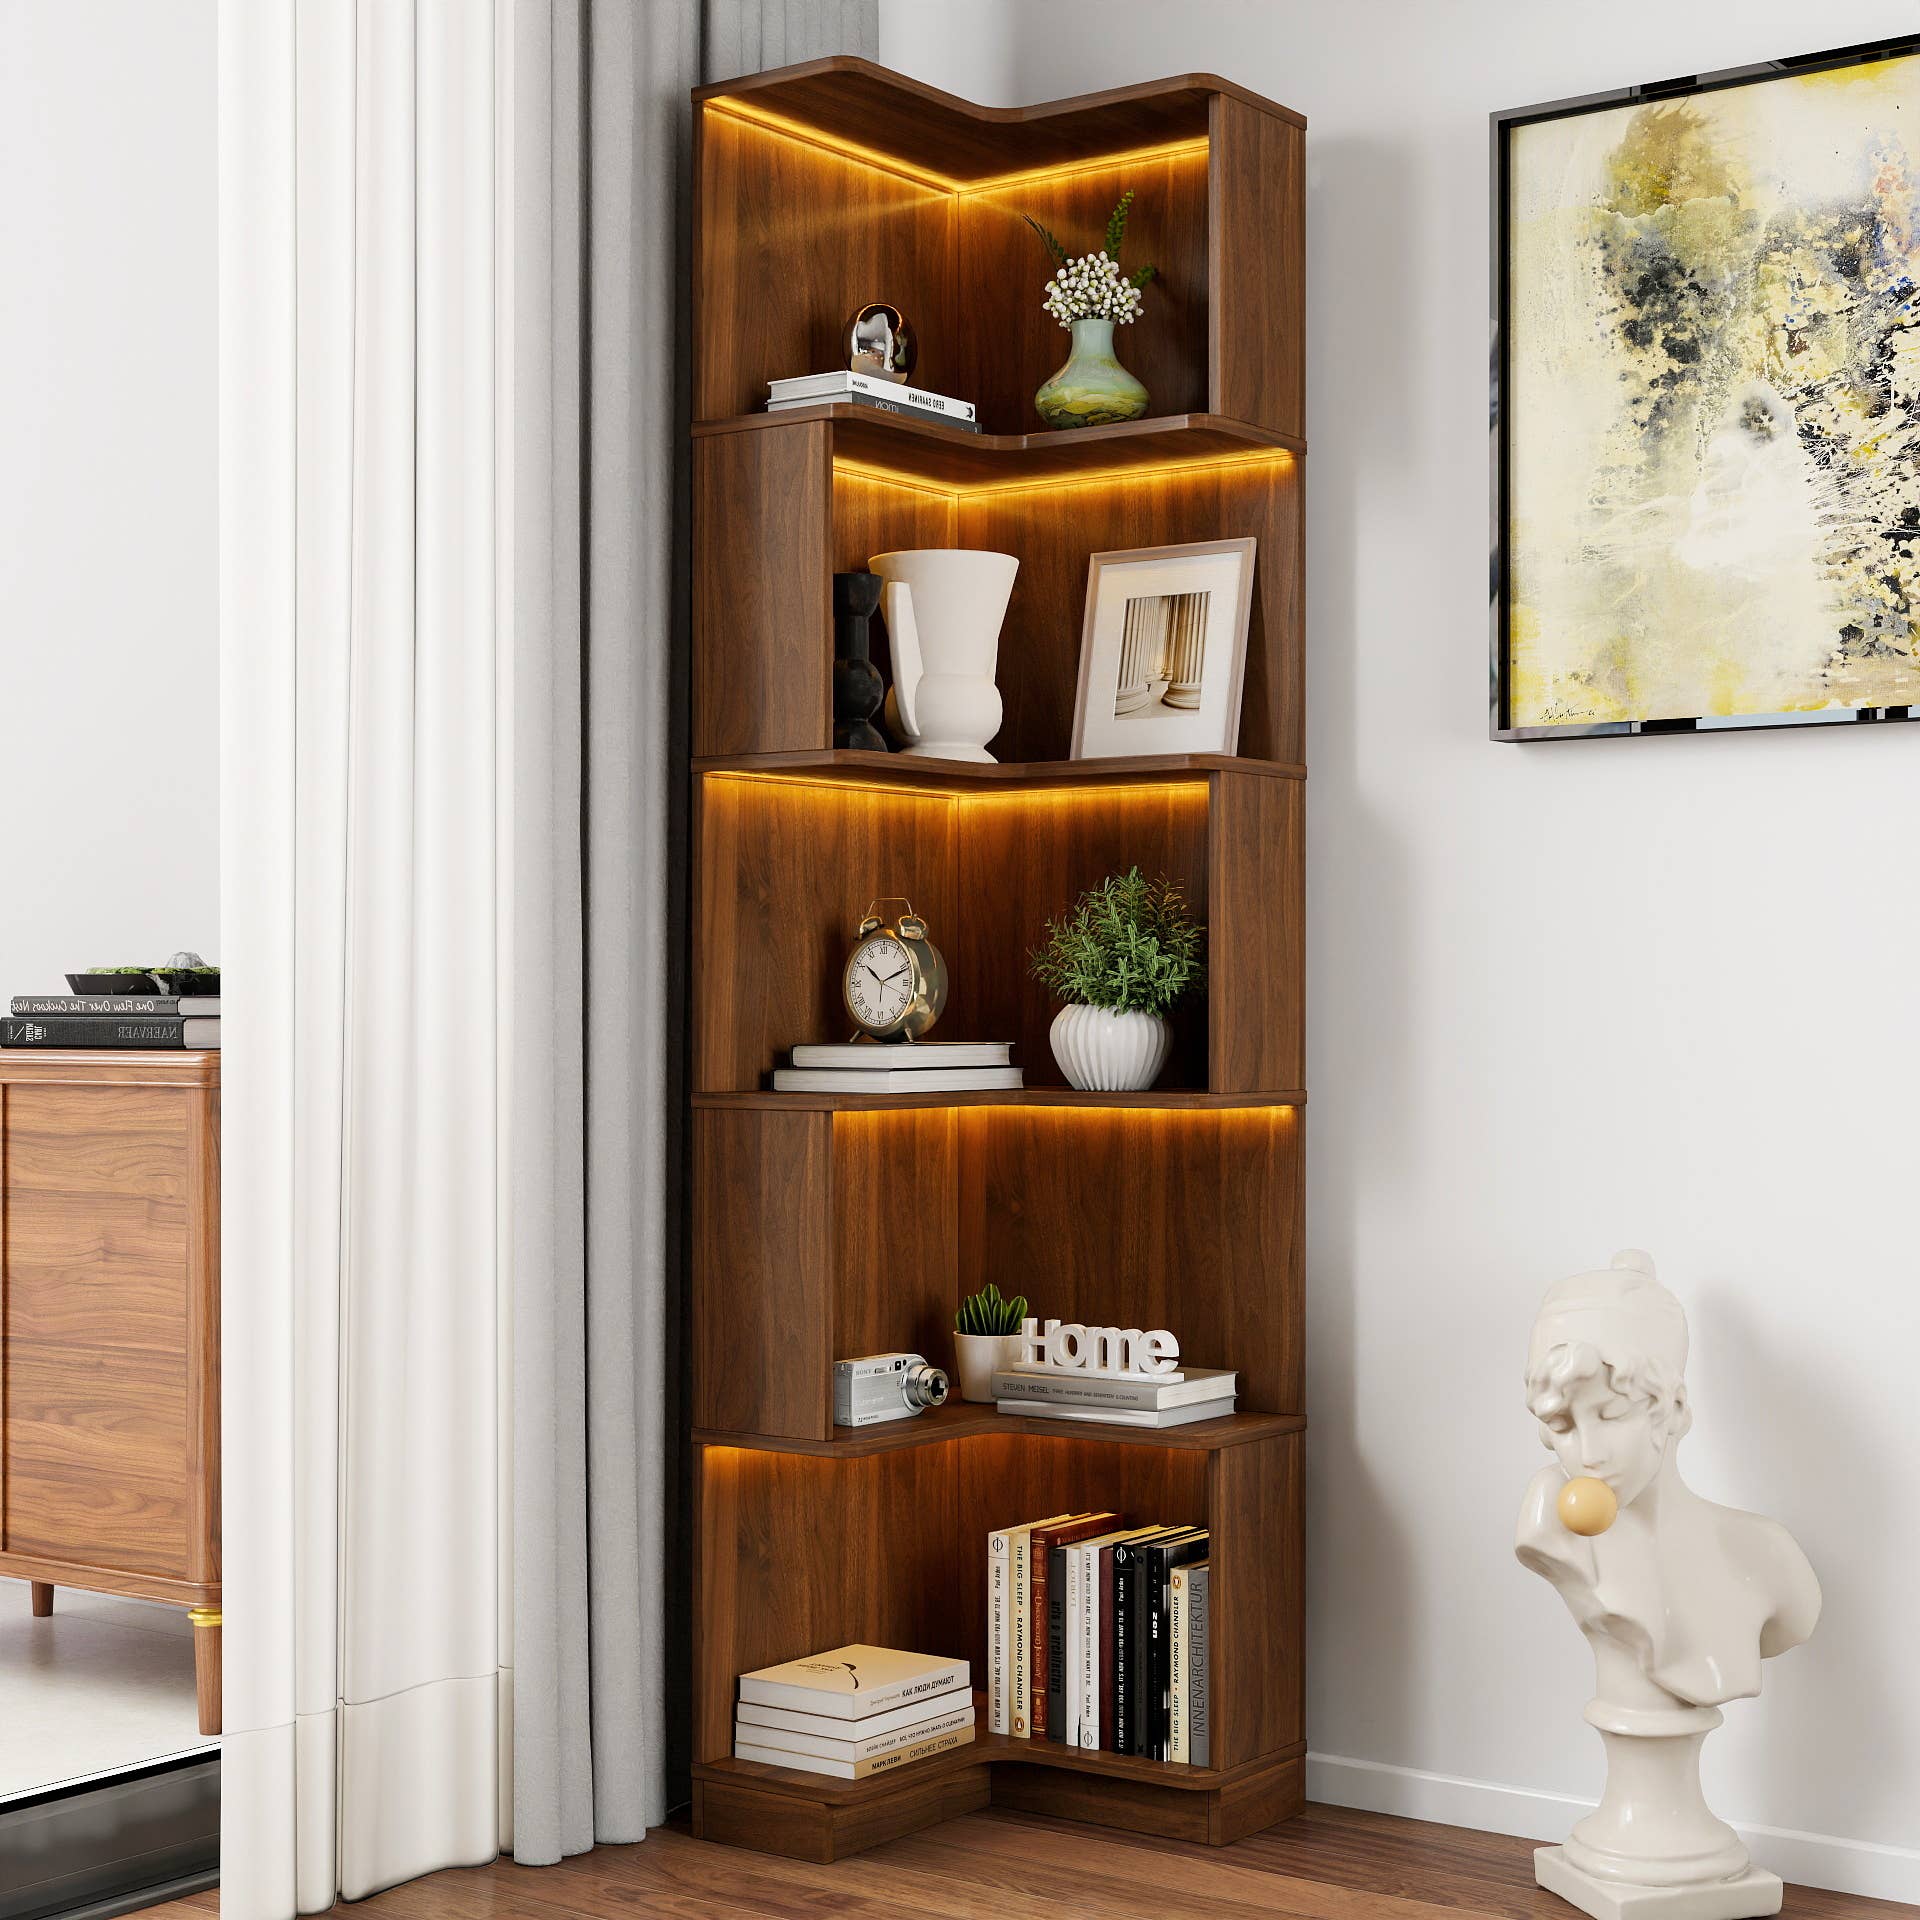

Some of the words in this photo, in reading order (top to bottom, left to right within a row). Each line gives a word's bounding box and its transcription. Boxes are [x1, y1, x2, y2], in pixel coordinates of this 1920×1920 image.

[880, 946, 888, 954] XII
[1021, 1318, 1180, 1374] Home
[1002, 1383, 1025, 1392] STEVEN
[1028, 1384, 1050, 1394] MEISEL
[1190, 1583, 1205, 1737] INNENARCHITEKTUR
[902, 1687, 914, 1697] КАК
[914, 1682, 931, 1695] ЛЮДИ
[931, 1675, 954, 1690] ДУМАЮТ
[872, 1759, 887, 1770] МАРК
[887, 1755, 902, 1765] ЛЕВИ
[909, 1743, 937, 1758] СИЛЬНЕЕ
[938, 1736, 958, 1749] СТРАХА
